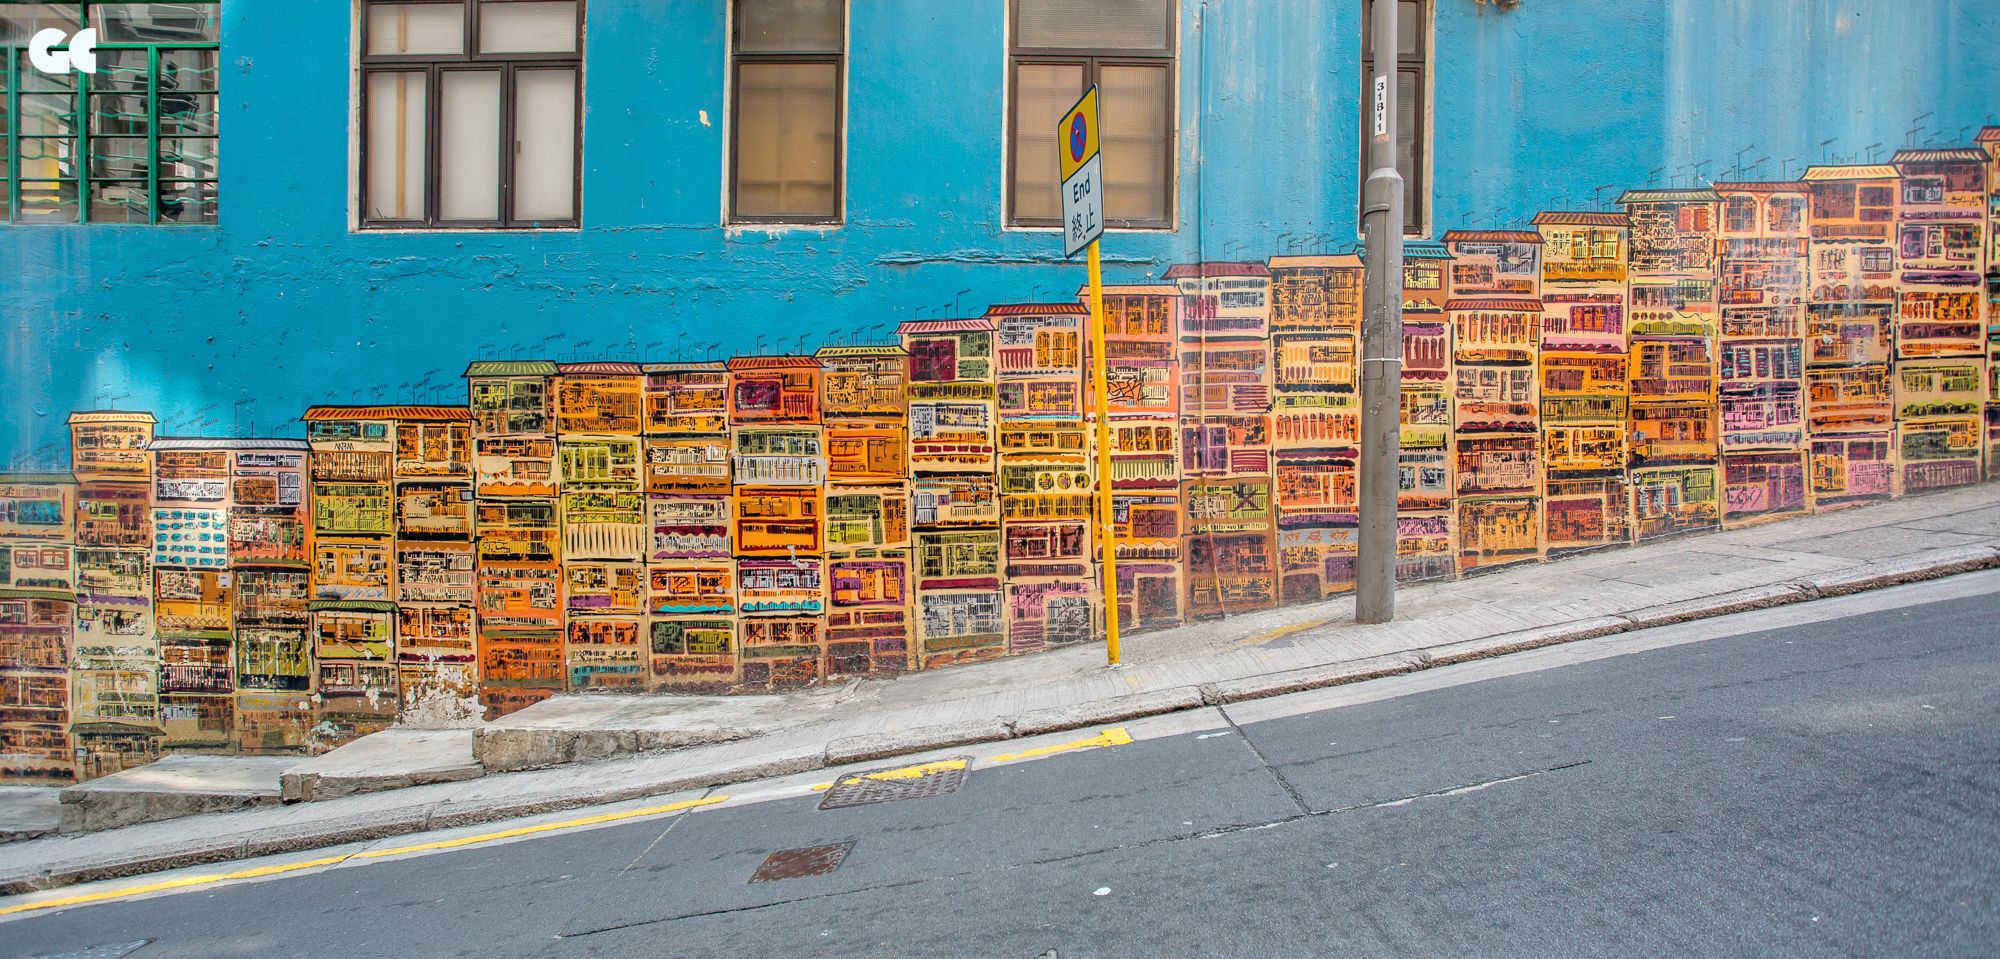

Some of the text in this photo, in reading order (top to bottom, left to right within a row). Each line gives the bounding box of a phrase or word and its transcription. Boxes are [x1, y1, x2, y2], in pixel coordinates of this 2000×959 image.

[1376, 82, 1384, 132] 31811
[1073, 172, 1090, 204] End
[1072, 203, 1095, 242] 終止
